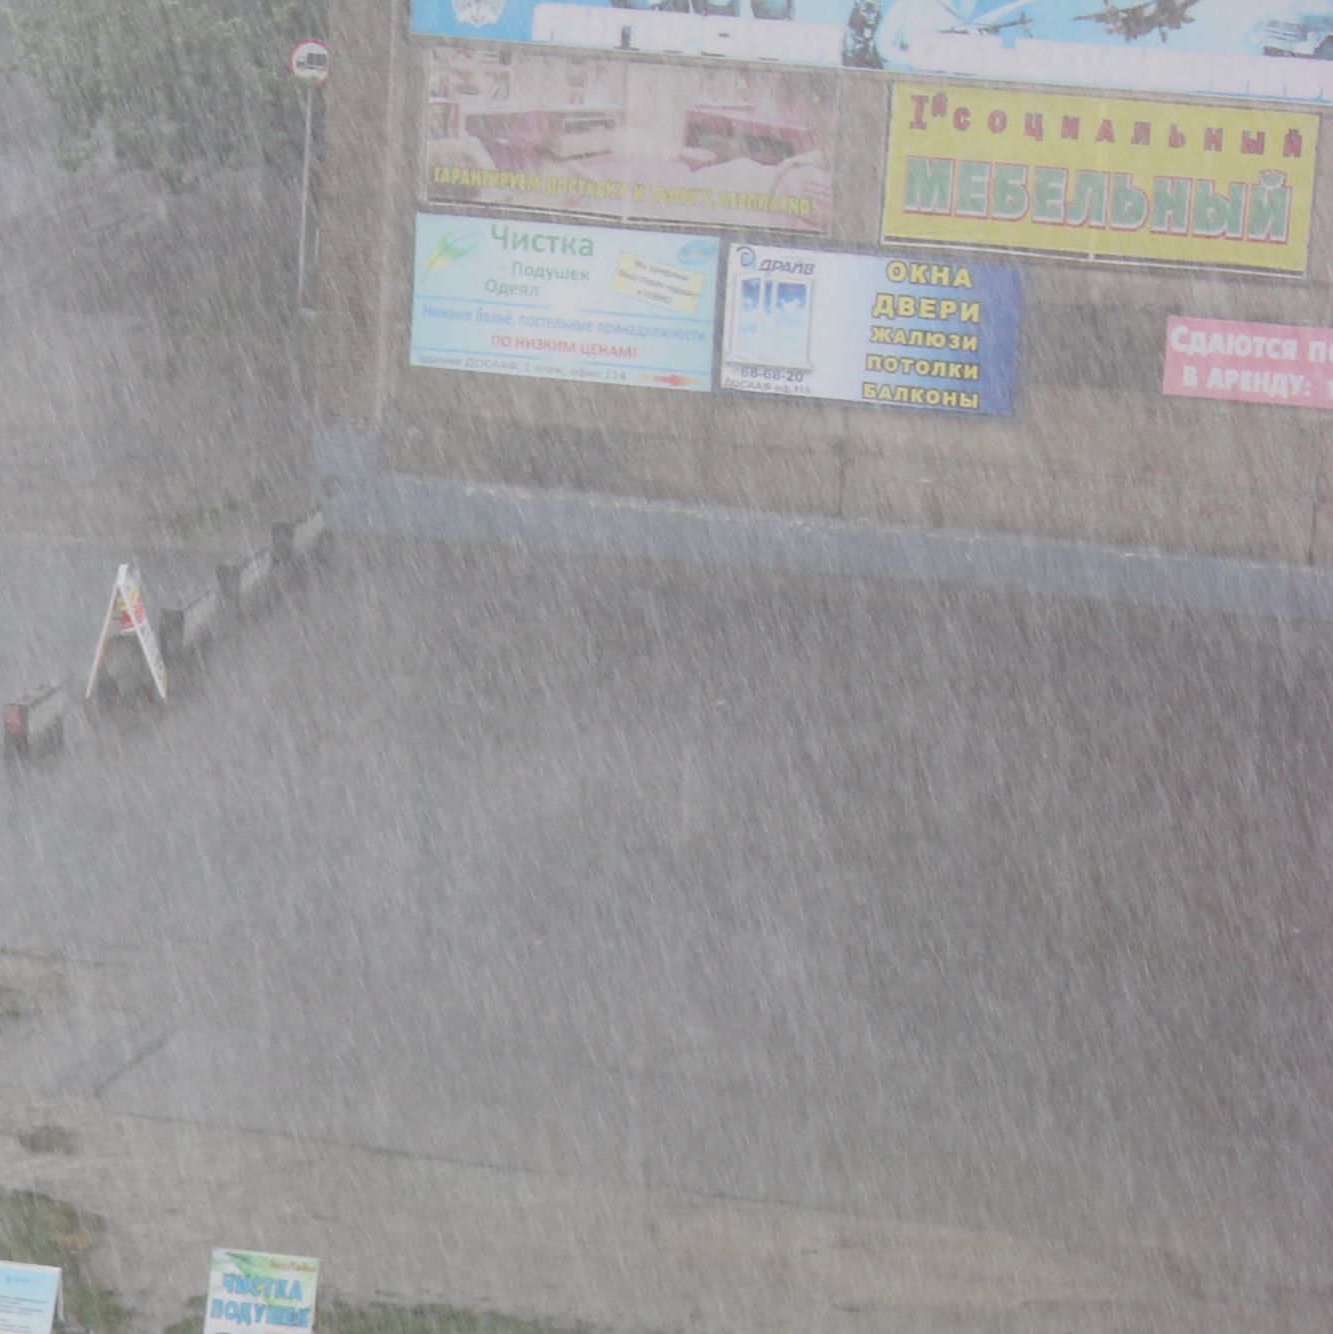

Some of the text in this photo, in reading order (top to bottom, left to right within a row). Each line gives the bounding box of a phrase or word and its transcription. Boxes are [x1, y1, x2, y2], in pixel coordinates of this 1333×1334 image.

[953, 105, 1304, 158] СОЦИАЛЬНЫЙ
[433, 166, 541, 193] ГАРАНТИРУЕМ
[546, 177, 629, 202] ДОСТАВКУ
[634, 184, 644, 202] И
[903, 155, 1293, 245] МЕБЕЛЬНЫЙ
[490, 224, 595, 257] Чистка
[512, 262, 589, 282] Подушек
[758, 258, 815, 276] ДРАЙВ
[886, 261, 973, 288] ОКНА
[485, 279, 539, 298] Одеял
[872, 293, 981, 322] ДВЕРИ
[423, 304, 473, 322] Нижнее
[519, 315, 594, 332] постельные
[597, 320, 705, 342] принадлежности
[491, 335, 637, 359] ПО НИЗКИМ ЦЕНАМ!
[870, 326, 978, 351] ЖАЛЮЗИ
[1171, 325, 1333, 363] СДАЮТСЯ П
[866, 355, 978, 380] ПОТОЛКИ
[862, 383, 979, 409] БАЛКОНЫ
[1183, 365, 1198, 387] В
[1206, 367, 1312, 399] АРЕНДУ:
[222, 1273, 304, 1301] ЧИСТКА
[210, 1299, 312, 1327] ПОДУШЕК
